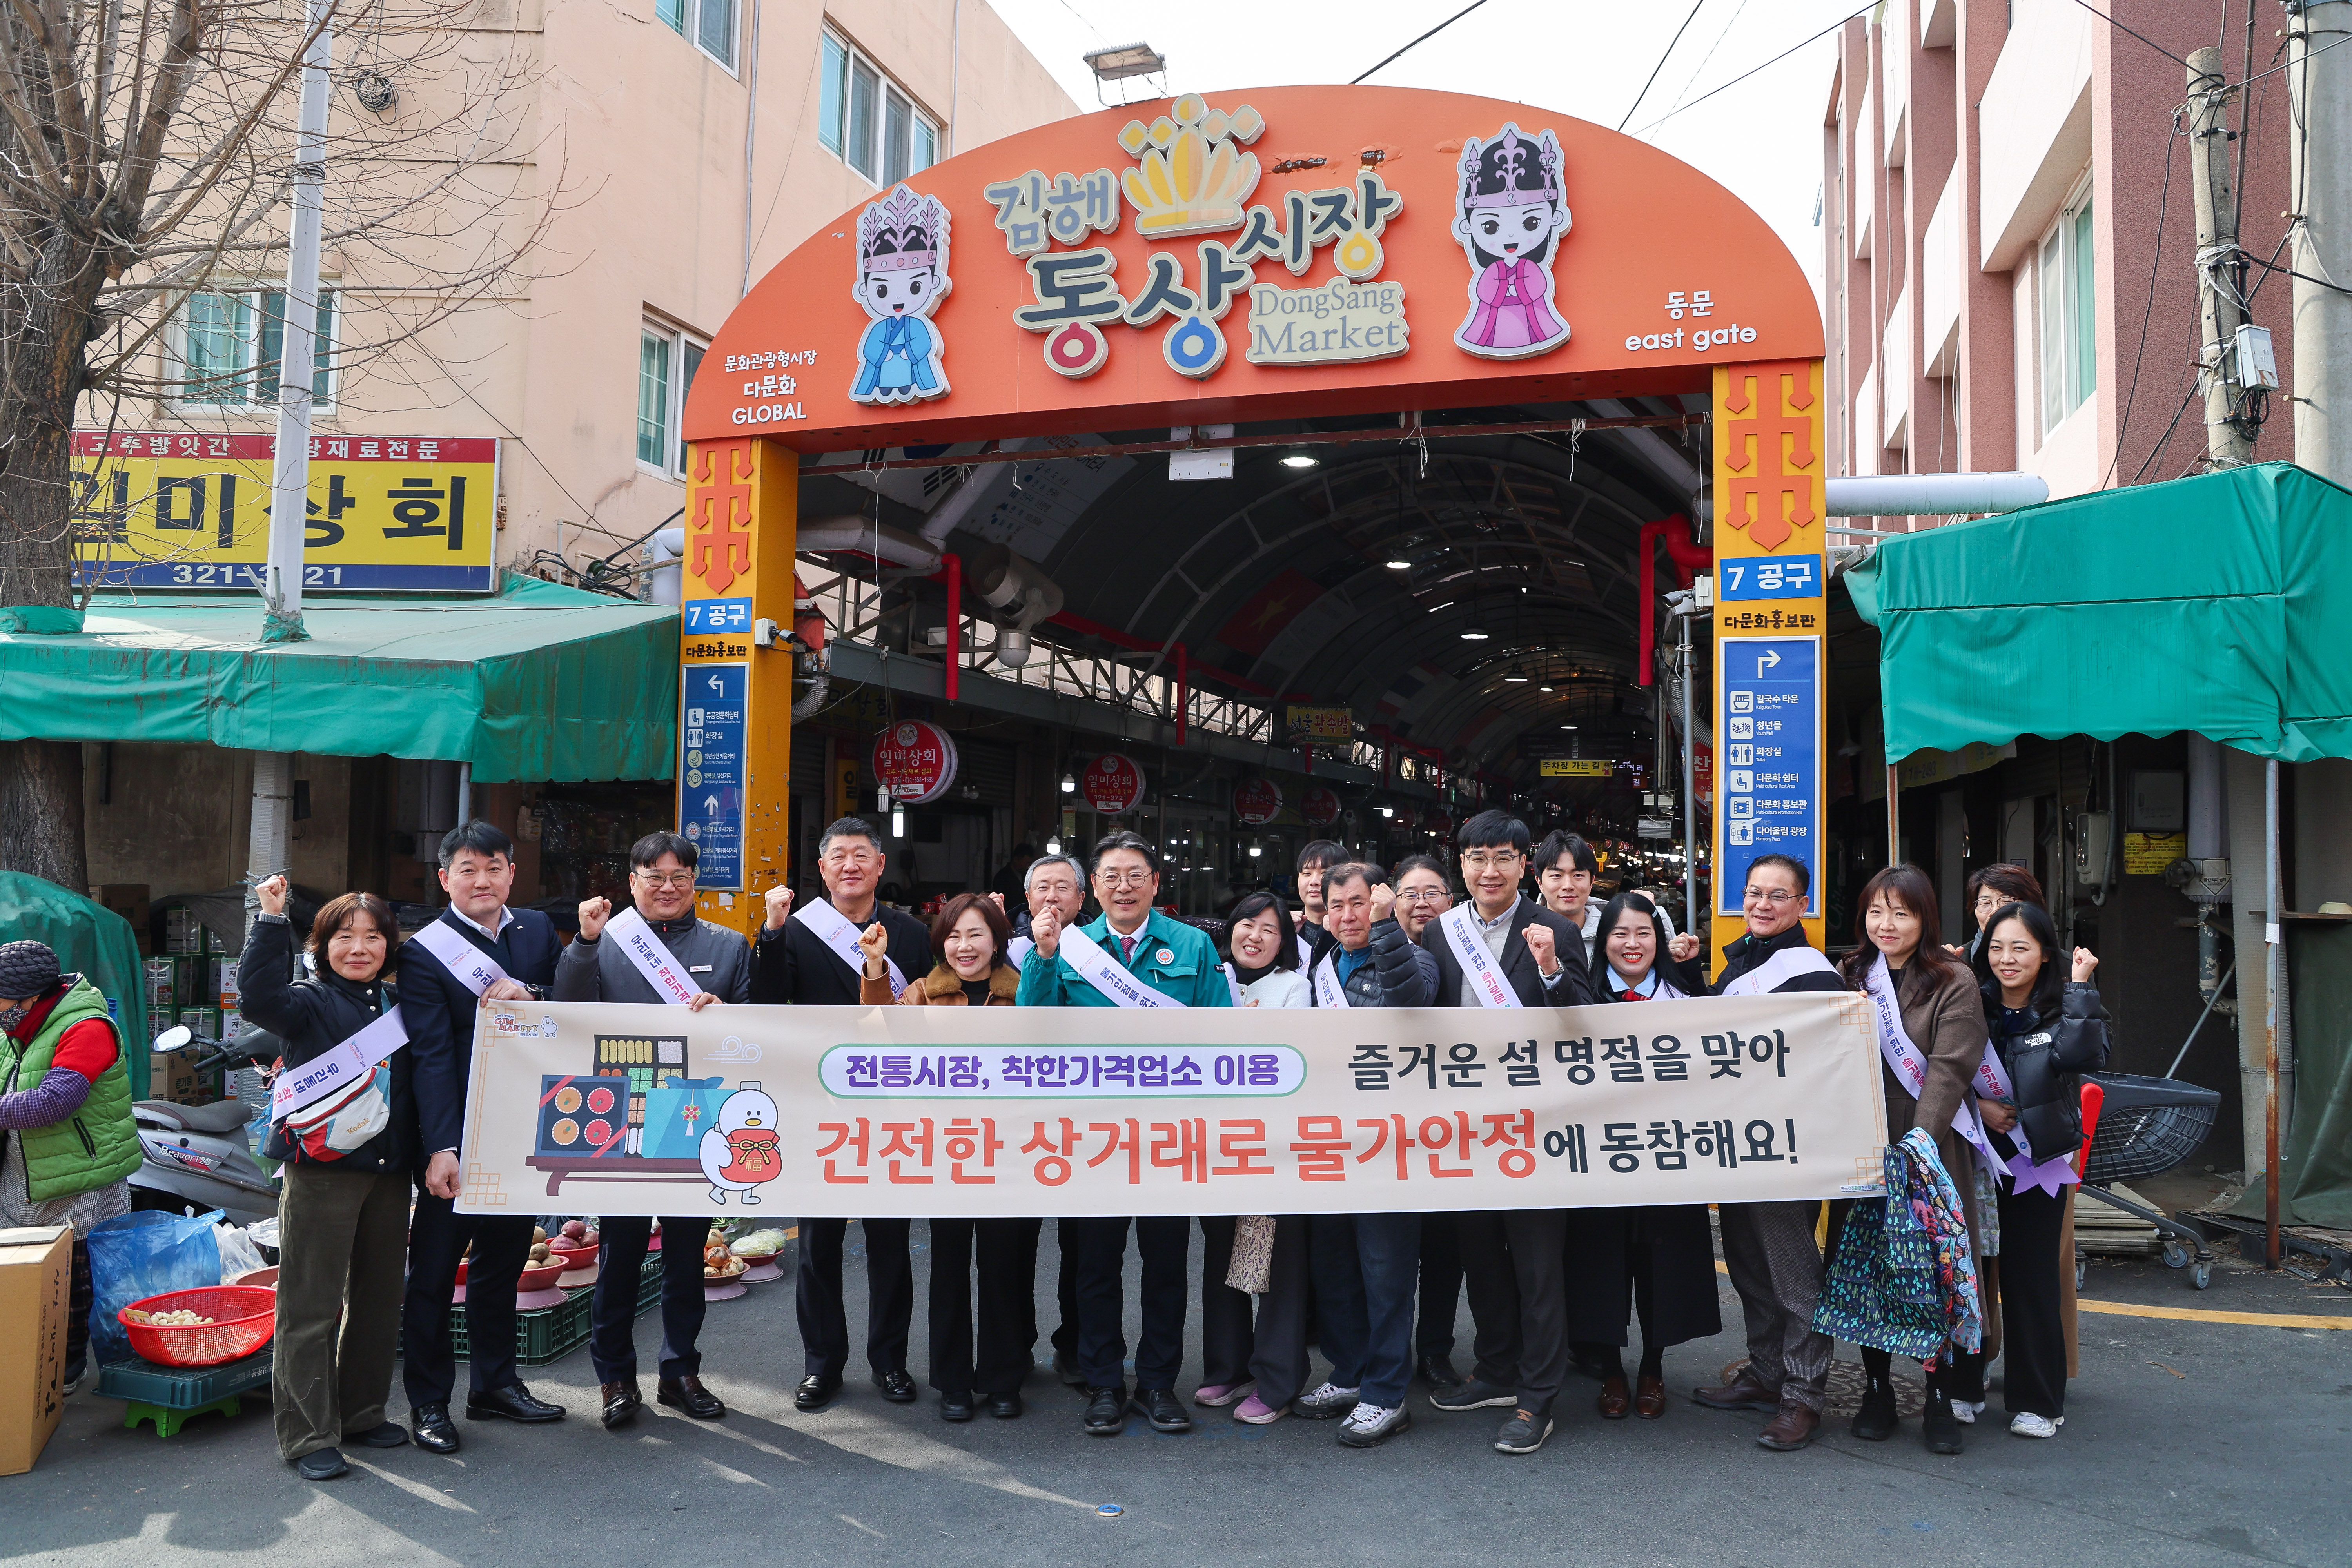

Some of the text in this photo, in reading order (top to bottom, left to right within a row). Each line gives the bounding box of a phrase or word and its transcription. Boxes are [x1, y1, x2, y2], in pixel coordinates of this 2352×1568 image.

[989, 175, 1109, 249] 김해
[1256, 285, 1395, 319] DongSang
[1665, 290, 1714, 320] 동문
[1256, 316, 1399, 356] Market
[1625, 323, 1757, 354] east gate
[724, 349, 817, 373] 문화관광형시장
[743, 374, 796, 399] 다문화
[732, 401, 807, 425] GLOBAL
[89, 436, 440, 459] 고추방앗간 당재료전문
[173, 564, 341, 585] 321-321
[1727, 563, 1812, 591] 7 공구
[689, 604, 745, 626] 7 공구
[1724, 609, 1815, 629] 다문화홍보판
[686, 641, 747, 658] 다문화홍보판
[1756, 694, 1799, 704] 칼국수 타운
[706, 711, 739, 719] 류공정문화쉼터
[1290, 713, 1349, 735] 서울왕족발
[1756, 720, 1782, 730] 청년몰
[1756, 747, 1782, 756] 화장실
[1572, 761, 1589, 769] 가는
[1592, 761, 1600, 769] 길
[1088, 775, 1132, 788] 일미상회
[1756, 773, 1799, 783] 다문화 쉼터
[1756, 799, 1807, 809] 다문화 홍보관
[1756, 826, 1807, 836] 다어울림 광장
[1453, 918, 1476, 955] 물가안정을
[1471, 953, 1487, 972] 위한
[631, 935, 691, 1004] 우리동네 착한가격
[1100, 967, 1140, 1002] 물가안정을
[1321, 972, 1334, 1005] 우리동네
[1877, 994, 1895, 1038] 물가안정을
[1889, 1037, 1906, 1057] 위한
[1348, 1029, 1790, 1091] 즐거운 설 명절을 맞아
[293, 1062, 339, 1094] 우리동네
[846, 1054, 1279, 1090] 전통시장, 착한가격업소 이용
[346, 1117, 370, 1135] Kodak
[160, 1144, 212, 1166] Beaver125
[817, 1109, 1798, 1186] 건전한 상거래로 물가안정에 동참해요!
[746, 1156, 762, 1172] 福
